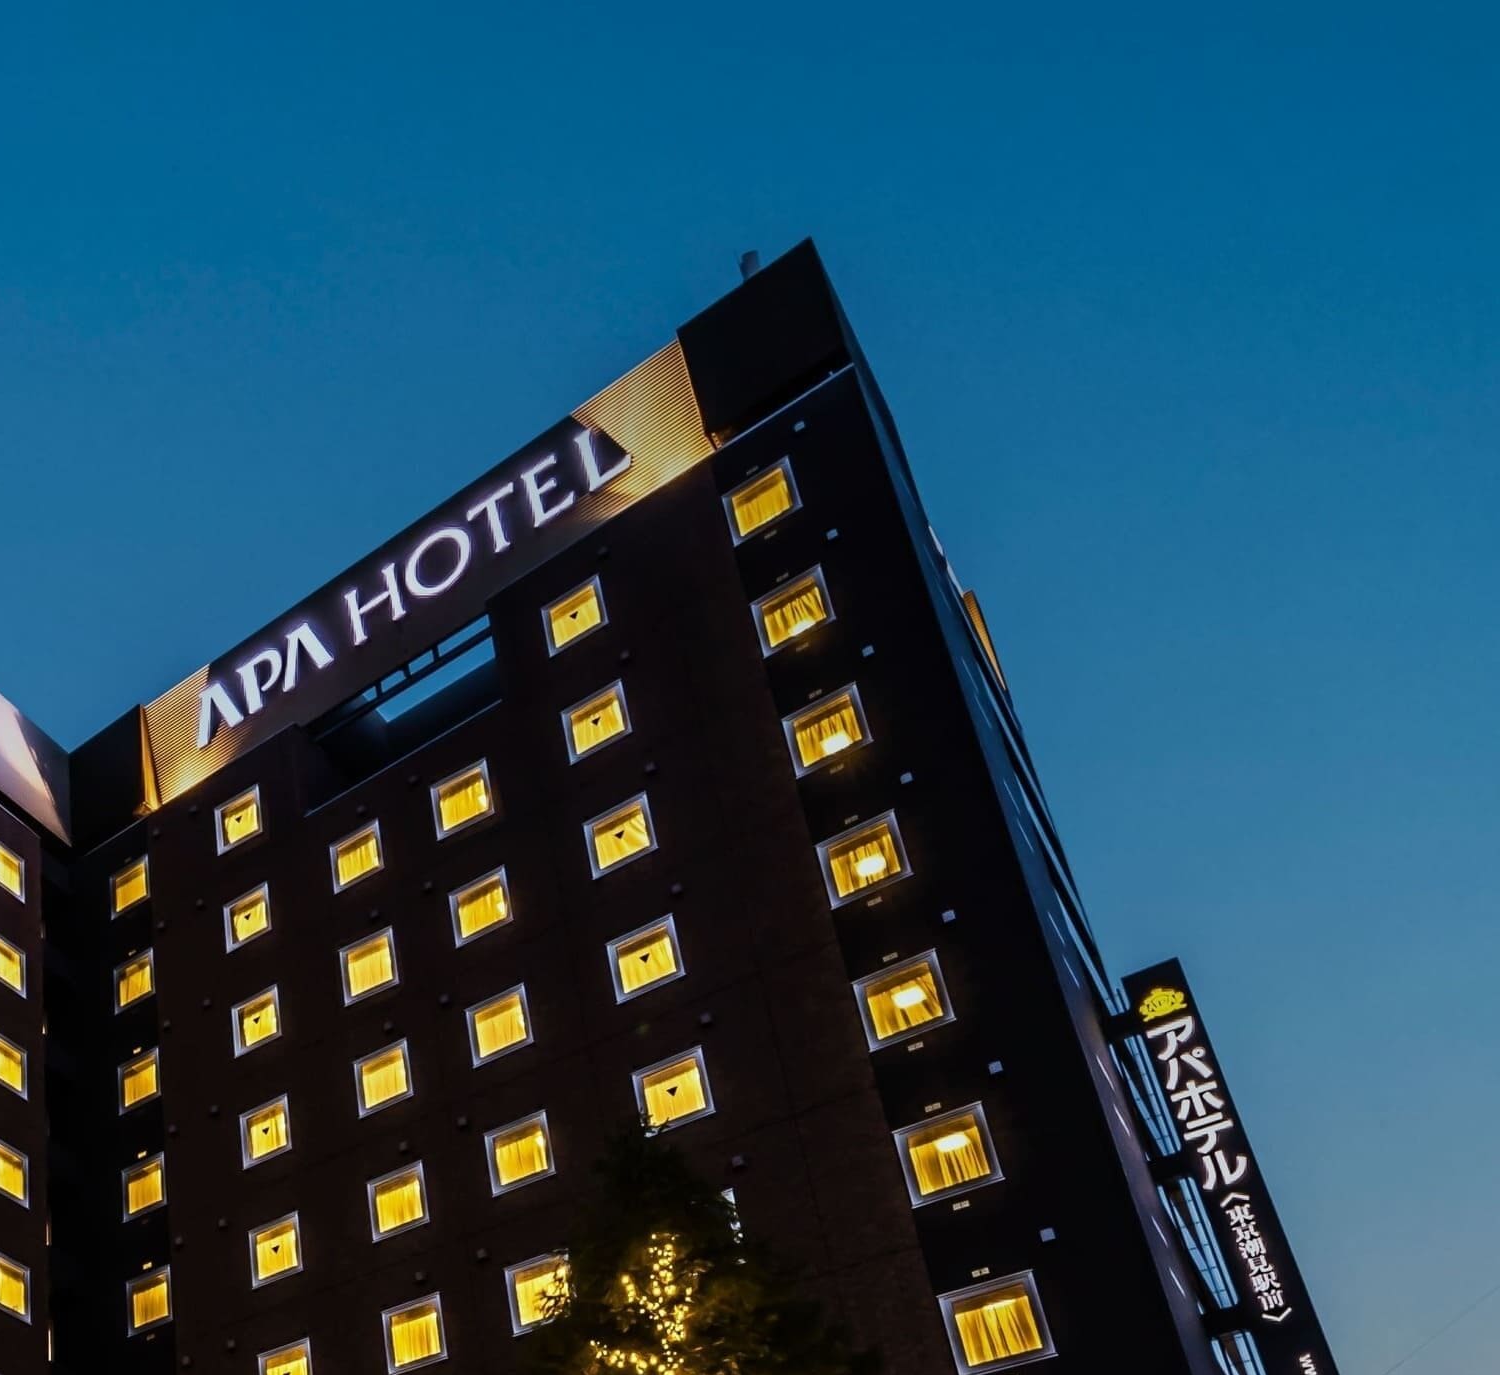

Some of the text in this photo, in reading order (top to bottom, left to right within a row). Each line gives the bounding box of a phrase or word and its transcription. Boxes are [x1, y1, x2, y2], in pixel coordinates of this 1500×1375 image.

[197, 429, 632, 749] APA HOTEL
[1146, 1015, 1248, 1191] アパホテル
